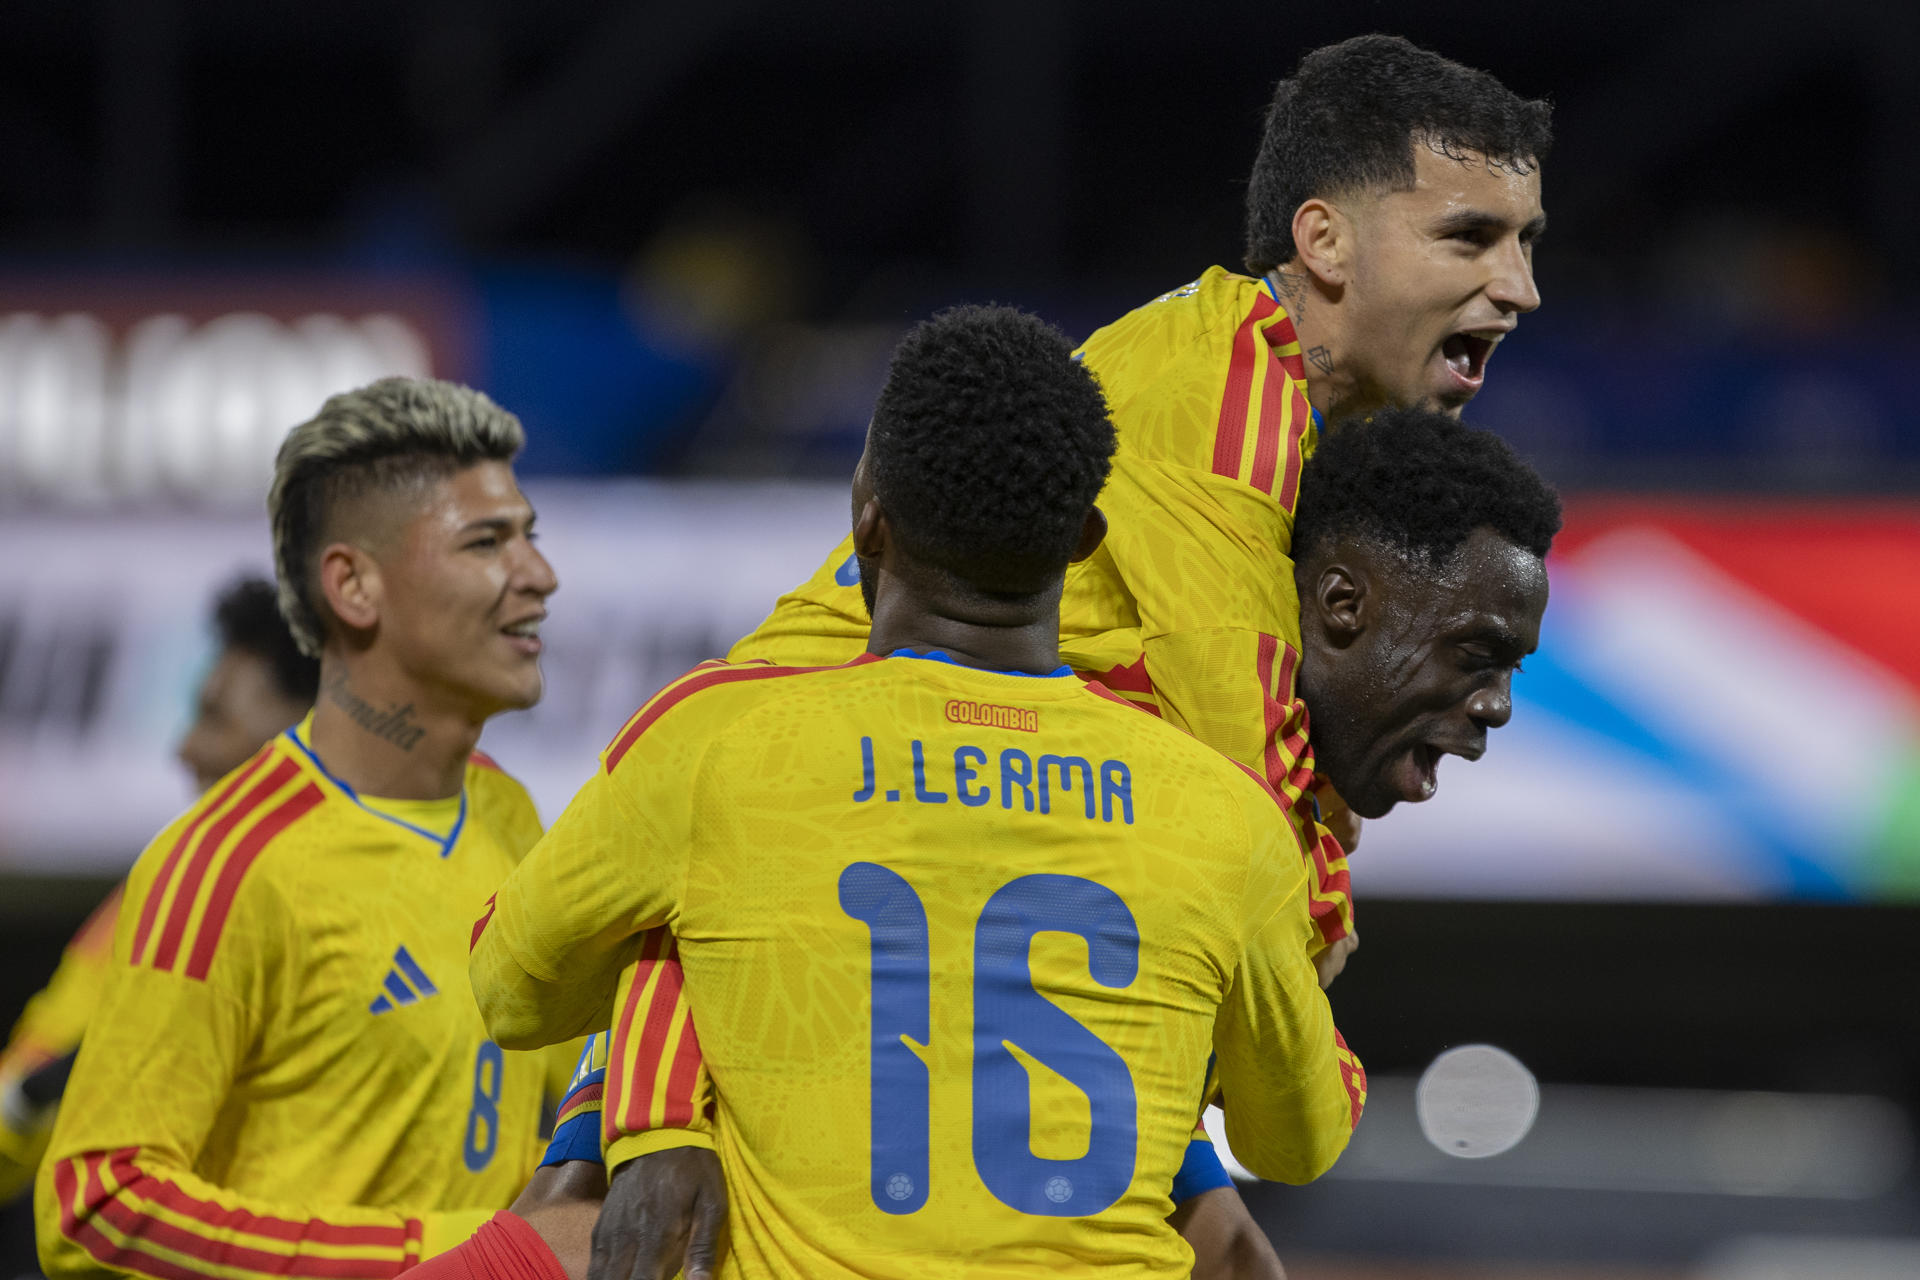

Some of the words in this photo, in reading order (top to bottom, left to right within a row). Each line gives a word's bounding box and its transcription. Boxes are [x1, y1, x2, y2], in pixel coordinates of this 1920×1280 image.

[945, 699, 1039, 733] COLOMBIA
[853, 736, 1134, 825] J.LERMA
[838, 861, 1140, 1217] 16
[463, 1040, 504, 1173] 8
